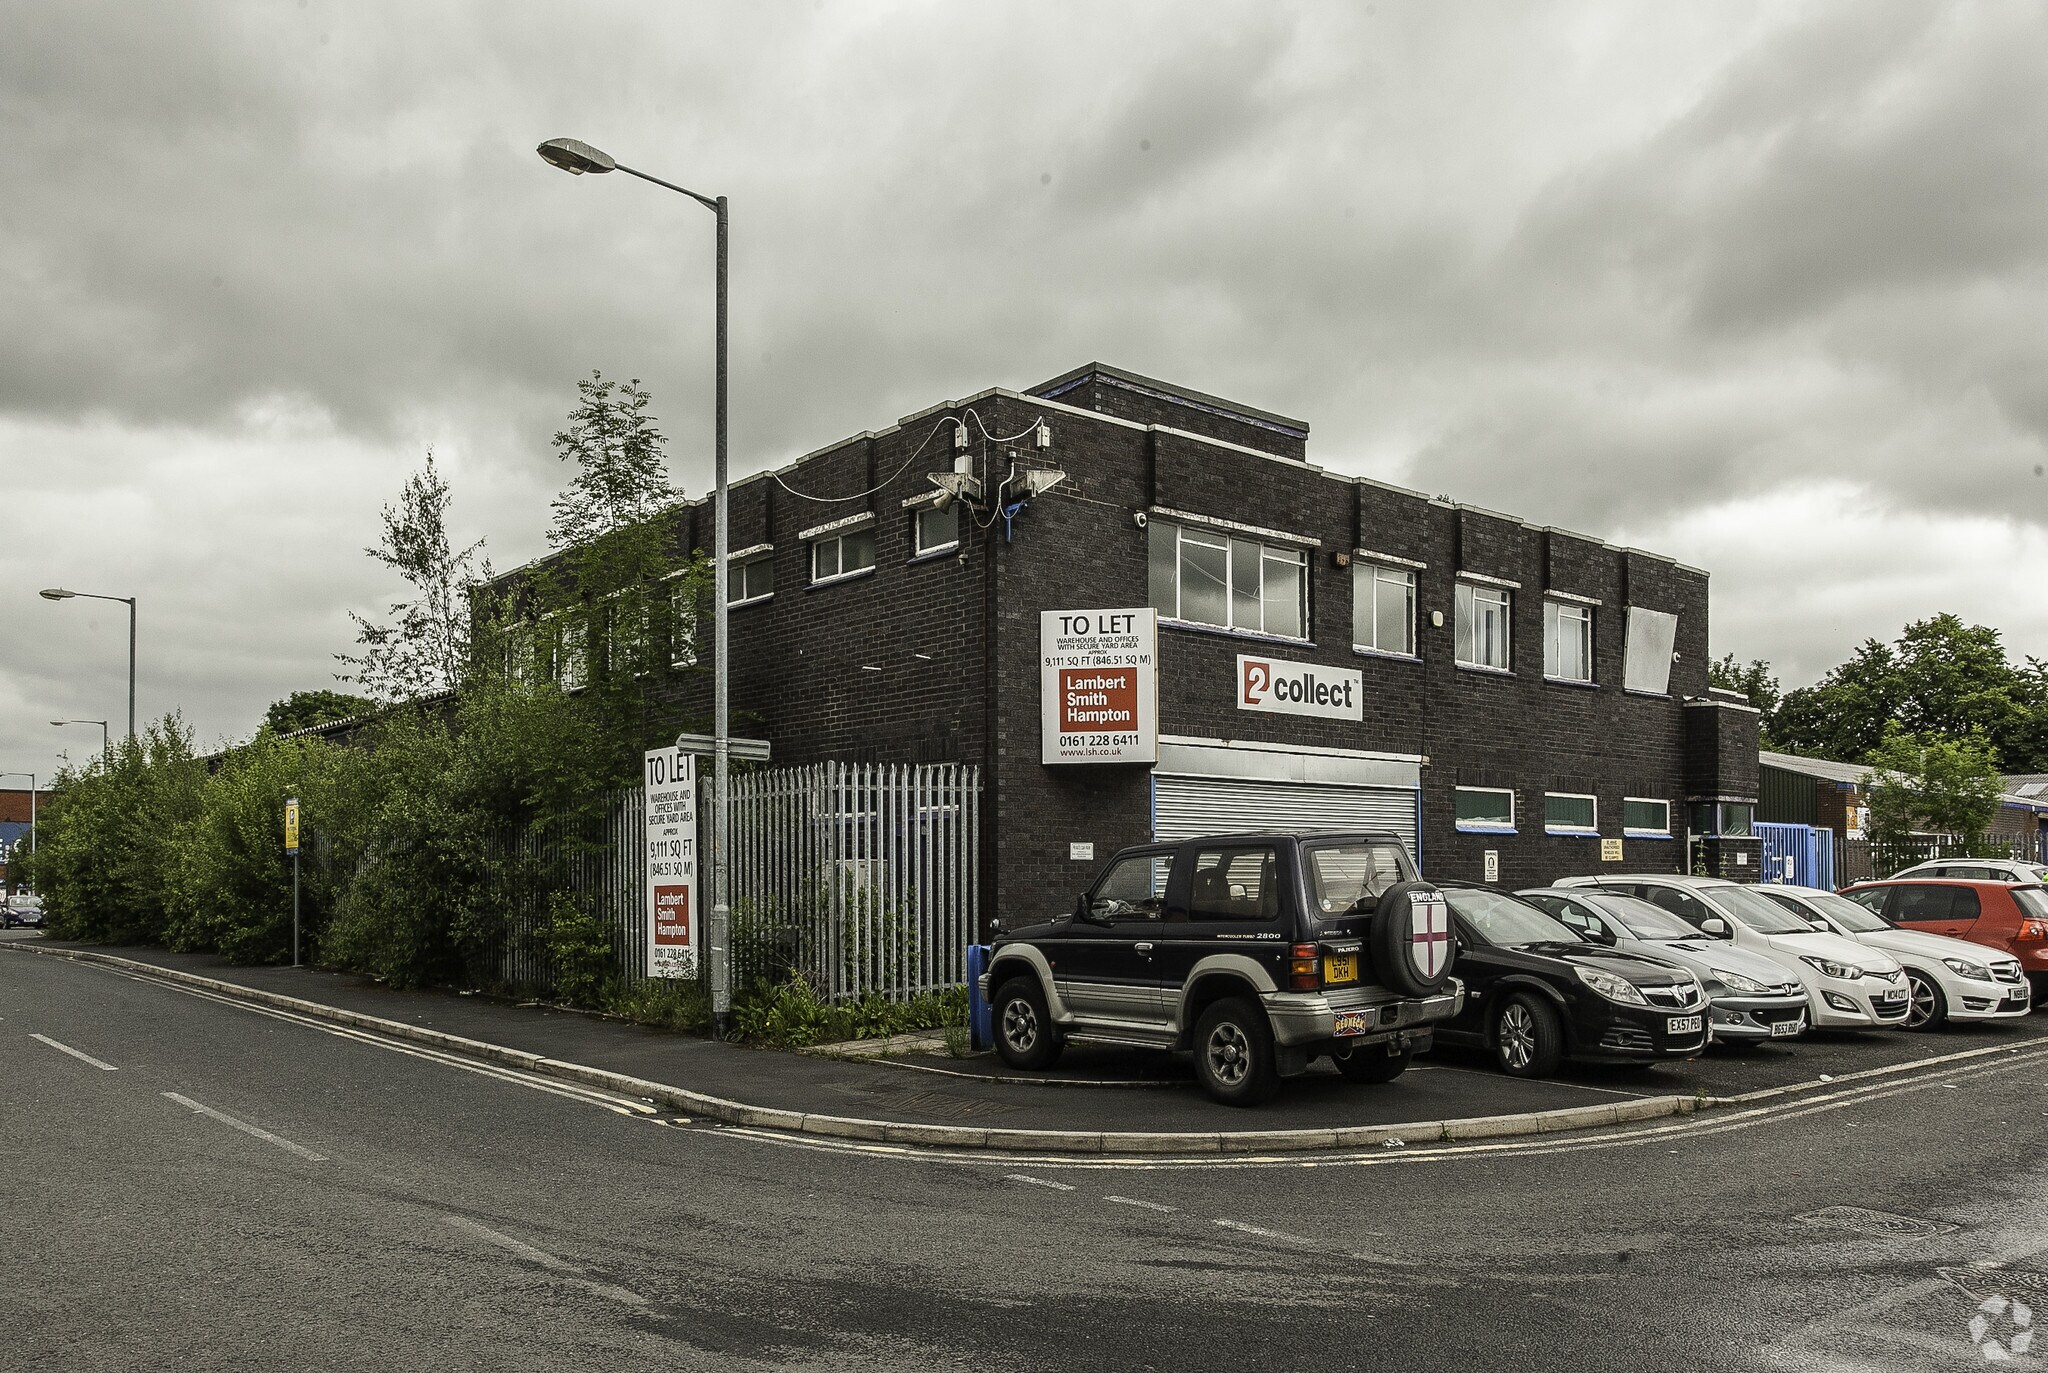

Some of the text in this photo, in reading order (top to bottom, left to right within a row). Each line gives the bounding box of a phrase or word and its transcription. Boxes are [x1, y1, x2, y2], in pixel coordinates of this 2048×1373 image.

[1059, 614, 1135, 635] TO LET
[1056, 636, 1097, 644] WAREHOUSE
[1114, 635, 1139, 643] OFFICES
[1045, 654, 1151, 667] 9,111 SQ FT (846.51 SQ M)
[1066, 675, 1126, 690] Lambert
[1247, 666, 1267, 701] 2
[1274, 673, 1352, 708] collect
[1066, 691, 1108, 706] Smith
[1067, 707, 1130, 724] Hampton
[1060, 734, 1139, 747] 0161 228 6411
[1060, 747, 1122, 757] www.lsh.co.uk
[648, 753, 692, 785] TO LET
[650, 789, 690, 803] WAREHOUSE AND
[655, 801, 687, 814] OFFICES WITH
[649, 811, 693, 825] SECURE YARD AREA
[663, 828, 678, 836] APPROX
[650, 839, 692, 860] 9,111 SQ FT
[650, 861, 693, 879] (846.51 SQ M)
[657, 892, 684, 906] Lambert
[1410, 892, 1444, 902] ENGLAND
[657, 907, 676, 921] Smith
[657, 922, 686, 938] Hampton
[655, 948, 666, 958] 0161
[1331, 955, 1350, 967] L951
[1333, 967, 1349, 978] DKH
[1335, 1017, 1366, 1031] REDNECK
[1671, 1018, 1690, 1031] EX57
